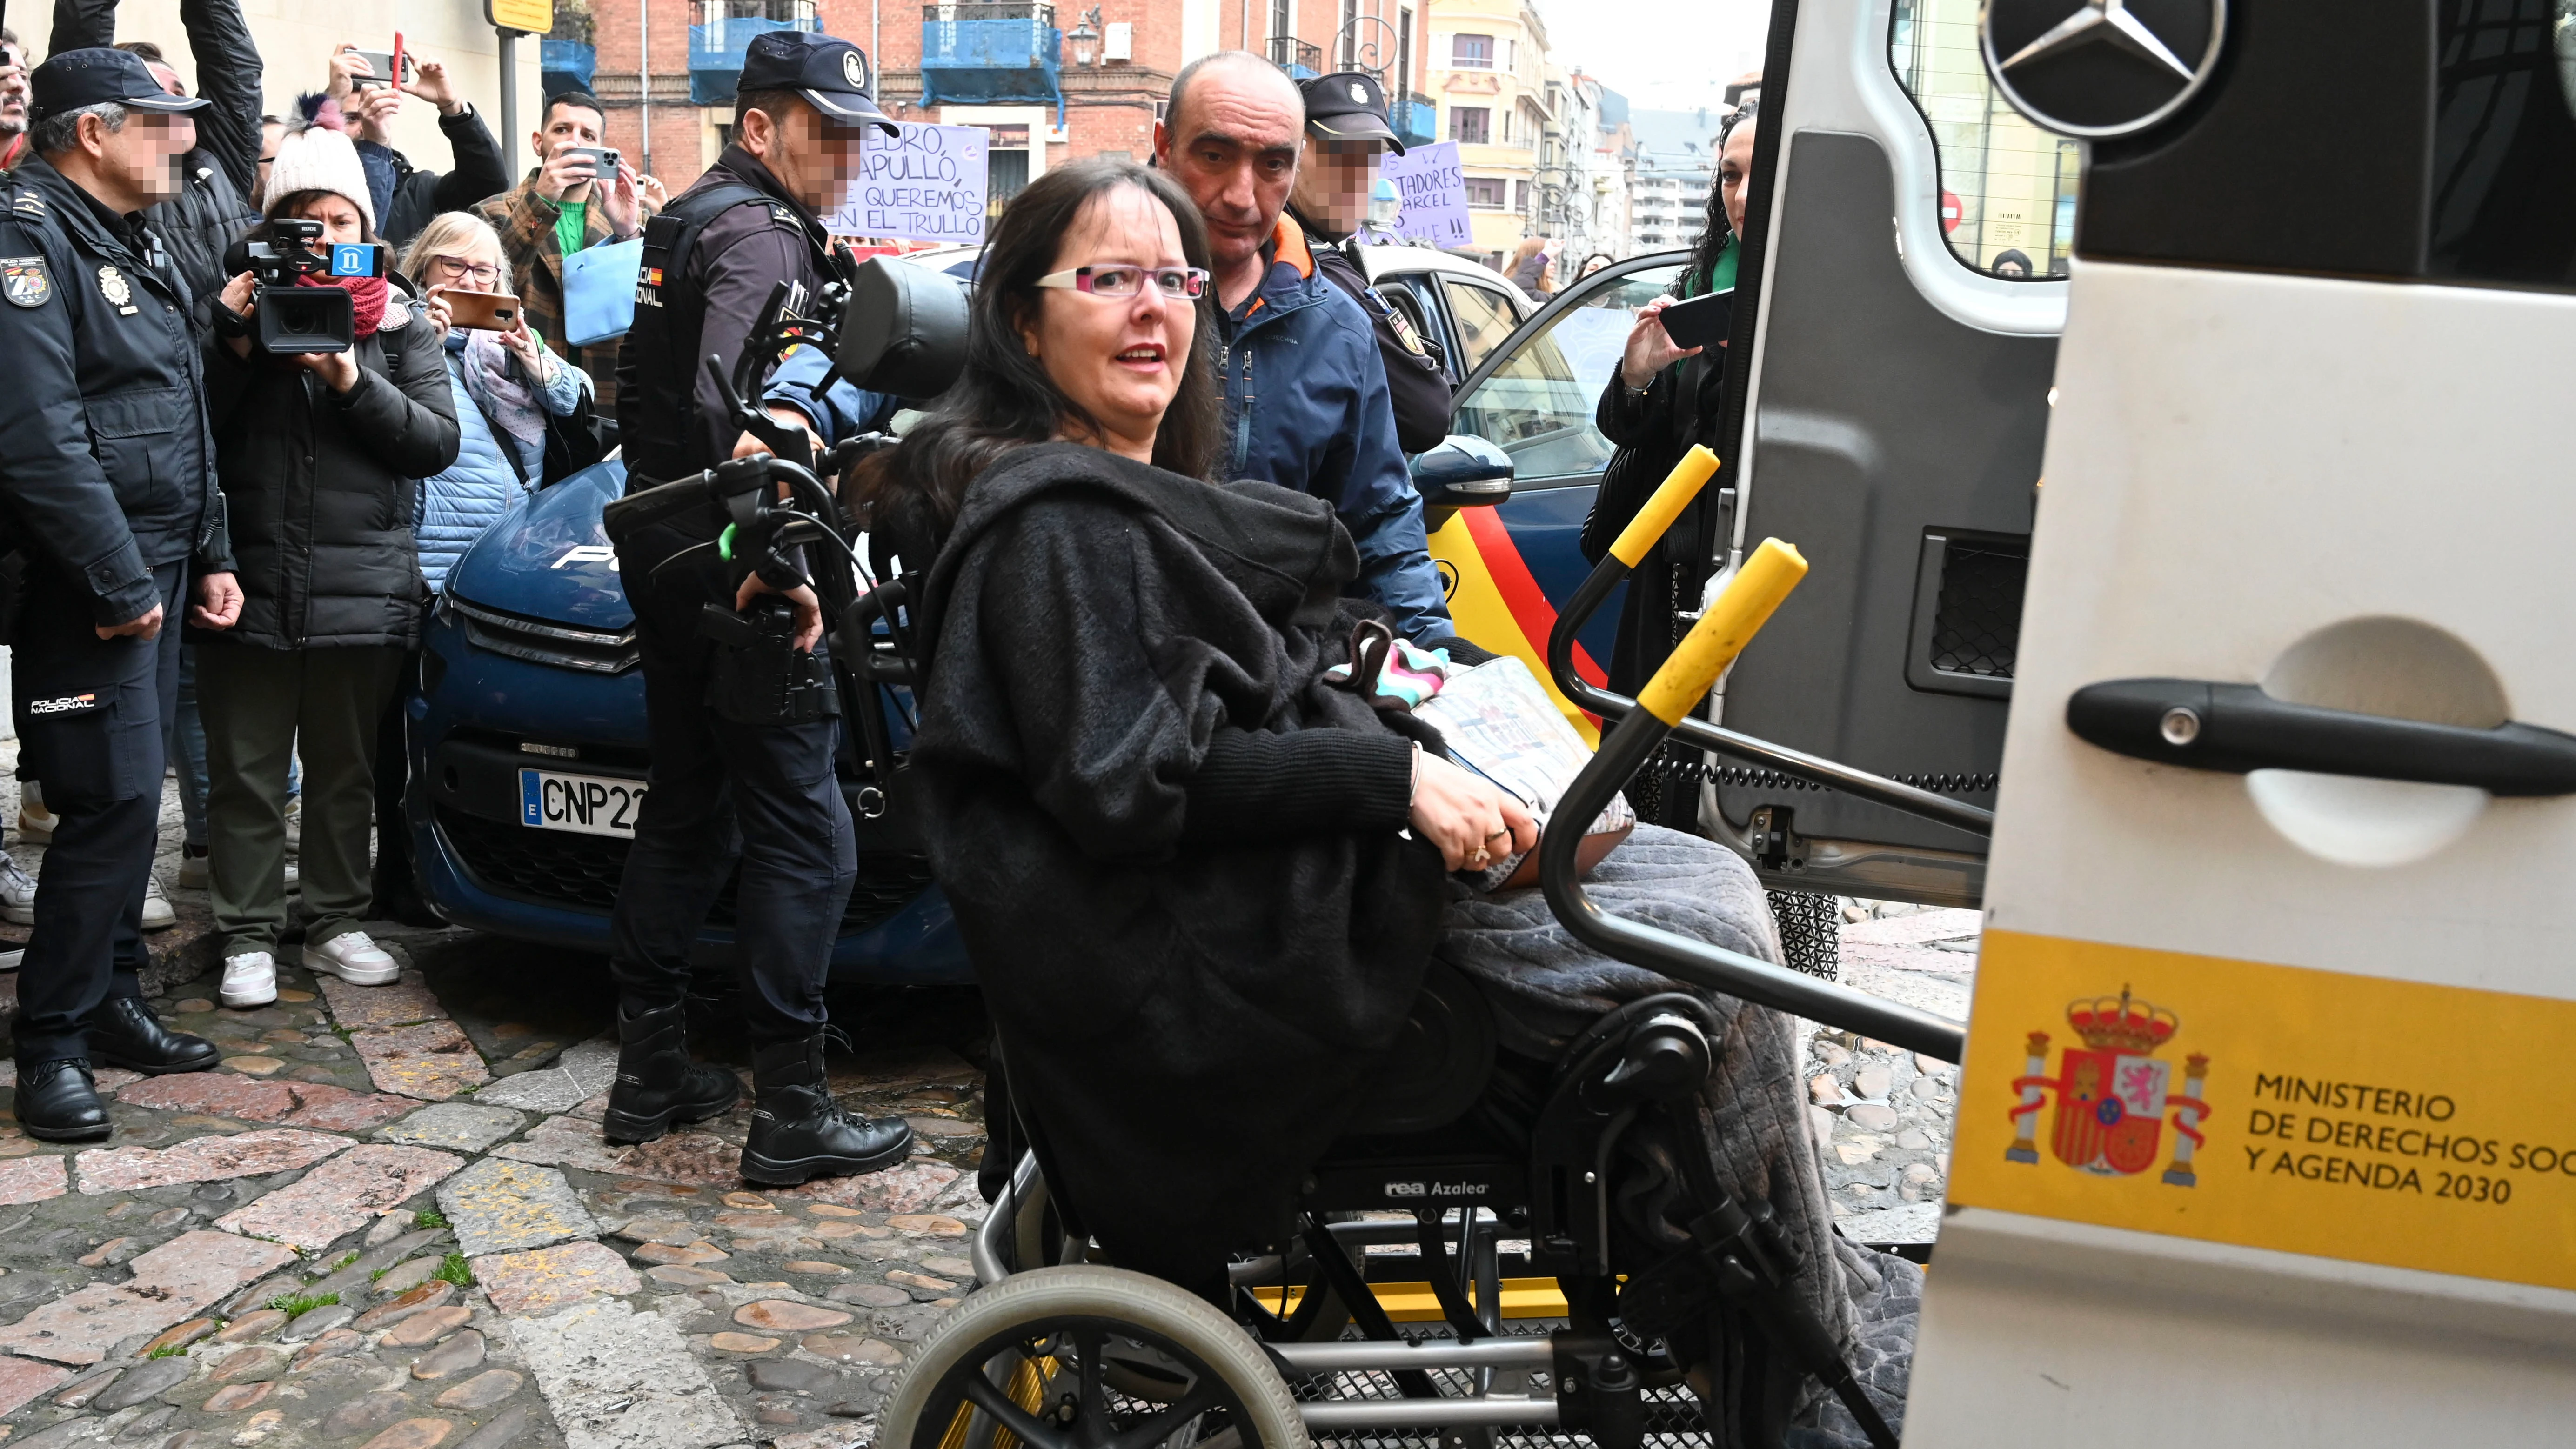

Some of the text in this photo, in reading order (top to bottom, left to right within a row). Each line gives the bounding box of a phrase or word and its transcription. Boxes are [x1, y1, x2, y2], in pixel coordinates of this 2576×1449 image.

[867, 125, 946, 156] EDRO,
[854, 154, 962, 188] APULLO,
[1389, 167, 1461, 196] TADORES
[865, 187, 983, 216] QUEREMOS
[868, 209, 896, 229] EL
[900, 212, 980, 235] TRULLO
[342, 252, 359, 269] n
[550, 545, 620, 571] P
[31, 696, 80, 708] POLICIA
[31, 701, 94, 714] NACIONAL
[529, 803, 536, 816] E
[2254, 1072, 2456, 1122] MINISTERIO
[2248, 1109, 2296, 1140] DE
[2306, 1117, 2499, 1166] DERECHOS
[2244, 1144, 2511, 1205] Y AGENDA 2030
[1386, 1182, 1425, 1195] rea
